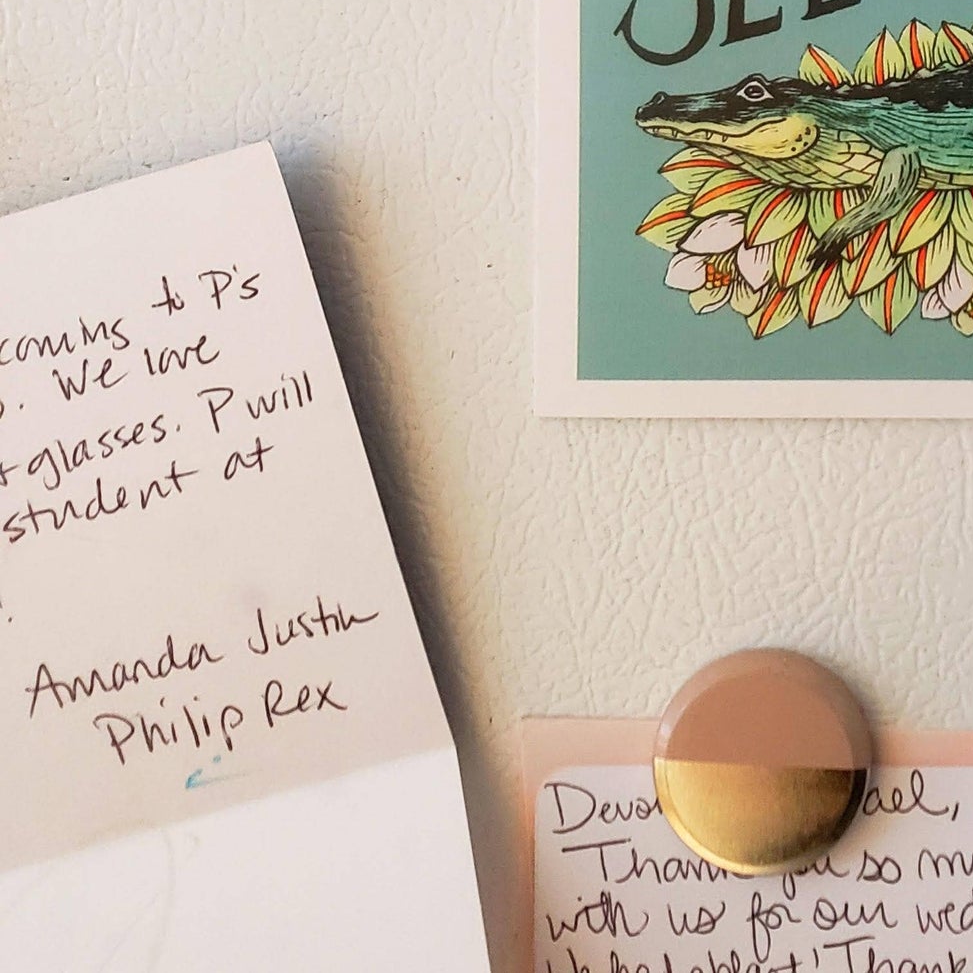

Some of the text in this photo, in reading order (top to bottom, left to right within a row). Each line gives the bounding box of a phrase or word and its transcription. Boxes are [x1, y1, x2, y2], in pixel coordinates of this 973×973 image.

[151, 275, 186, 316] to
[198, 264, 262, 310] P's
[52, 335, 220, 401] We love
[27, 413, 182, 491] glasses.
[197, 386, 234, 434] P
[246, 370, 314, 420] will
[2, 436, 275, 544] student at
[25, 595, 380, 719] Amanda Justin
[93, 680, 349, 765] Philip Rex
[561, 838, 755, 885] Than
[783, 856, 850, 901] yu
[858, 849, 902, 884] so
[546, 890, 650, 942] with
[667, 899, 727, 935] us
[746, 891, 800, 964] for
[812, 898, 898, 931] our
